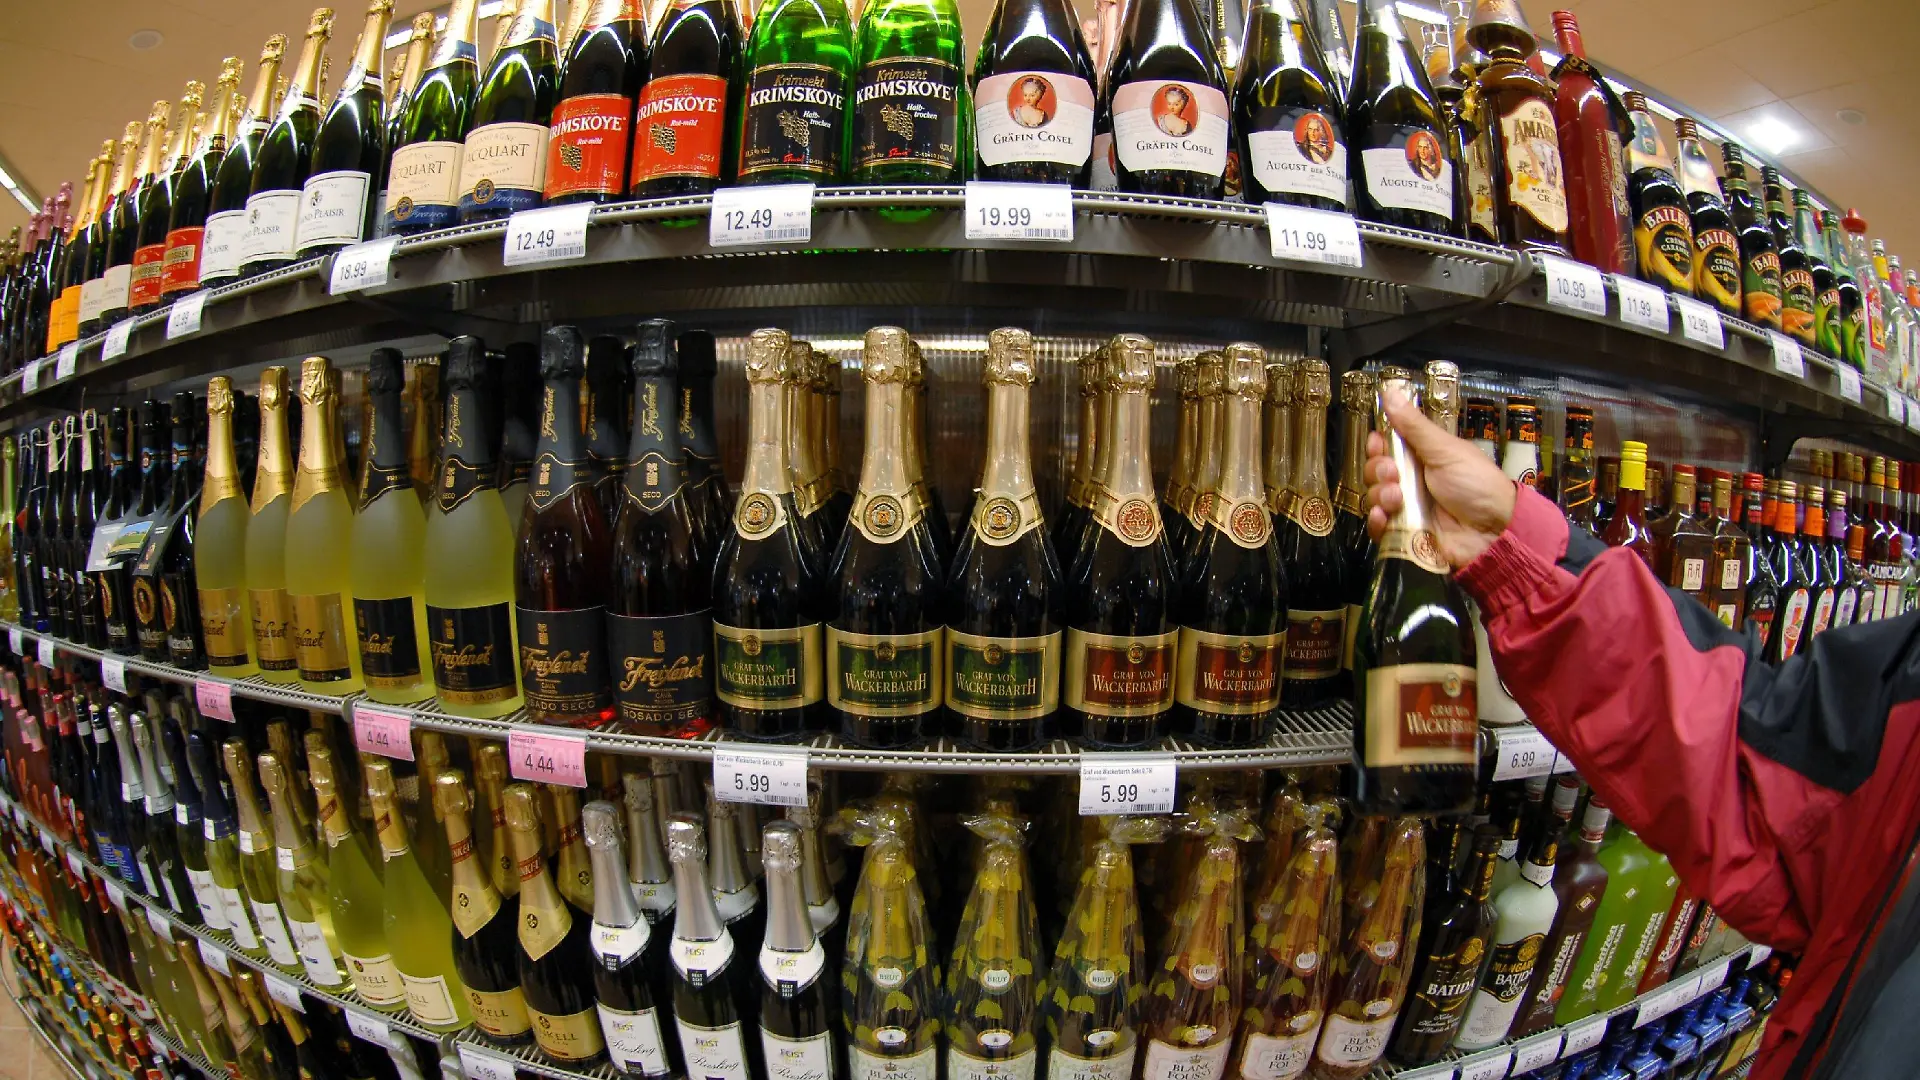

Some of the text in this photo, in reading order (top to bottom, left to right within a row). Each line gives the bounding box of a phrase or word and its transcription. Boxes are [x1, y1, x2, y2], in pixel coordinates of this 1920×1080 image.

[774, 74, 825, 88] Krimsekt
[876, 68, 928, 82] Krimsekt
[750, 85, 844, 111] KRIMSKOYE
[856, 79, 951, 105] KRIMSKOYE
[550, 115, 623, 141] RIMSKOYE
[992, 130, 1074, 146] GRÄFIN COSEL
[1136, 138, 1215, 156] GRÄFIN COSEL
[1266, 159, 1308, 173] AUGUST
[1380, 176, 1419, 188] AUGUST
[315, 206, 345, 220] PLAISIR
[724, 208, 773, 231] 12.49
[979, 207, 1031, 226] 19.99
[253, 225, 281, 237] PLAISIR
[516, 228, 555, 252] 12.49
[1281, 228, 1326, 251] 11.99
[340, 261, 368, 281] 18.99
[1556, 277, 1586, 299] 10.99
[1627, 296, 1652, 318] 11.99
[521, 645, 591, 677] Freixenet
[734, 661, 776, 674] GRAF VON
[619, 652, 705, 692] Freixenet
[721, 663, 796, 687] WACKERBARTH
[864, 669, 909, 679] GRAF VON
[972, 671, 1017, 682] GRAF VON
[1113, 669, 1156, 680] GRAF VON
[1203, 671, 1276, 692] WACKERBARTH
[1224, 669, 1263, 678] GRAF VON
[845, 672, 927, 694] WACKERBARTH
[956, 672, 1036, 696] WACKERBARTH
[1092, 672, 1170, 694] WACKERBARTH
[561, 699, 596, 711] SECO
[623, 708, 673, 722] ROSADO
[525, 753, 555, 774] 4.44
[1511, 751, 1535, 769] 6.99
[735, 773, 770, 793] 5.99
[1101, 784, 1138, 803] 5.99
[879, 973, 900, 982] BRUT
[987, 974, 1008, 983] BRUT
[1092, 975, 1113, 984] BRUT
[609, 1036, 656, 1056] Riesling
[688, 1054, 740, 1072] Riesling
